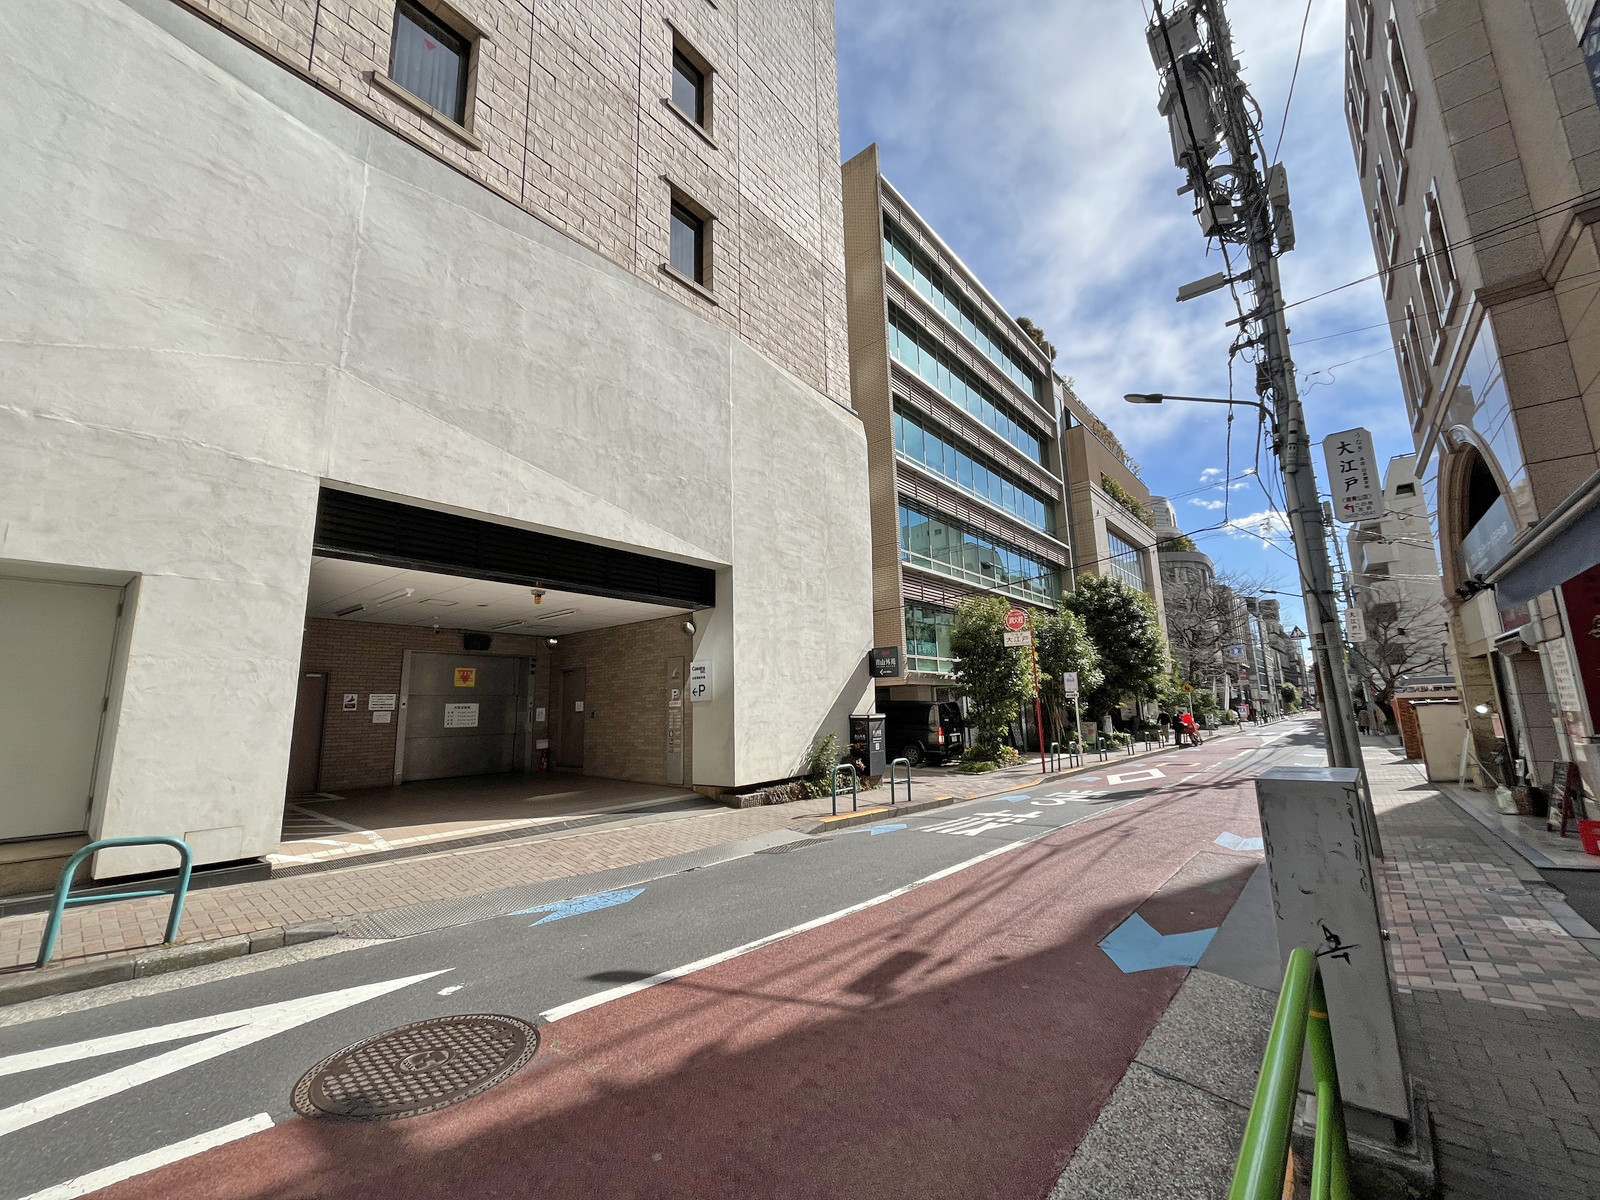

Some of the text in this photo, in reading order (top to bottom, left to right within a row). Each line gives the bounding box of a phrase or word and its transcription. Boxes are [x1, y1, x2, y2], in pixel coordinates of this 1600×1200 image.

[1336, 441, 1359, 493] 大江戸
[1008, 616, 1024, 624] 消火栓
[671, 689, 680, 701] P
[699, 684, 706, 696] P
